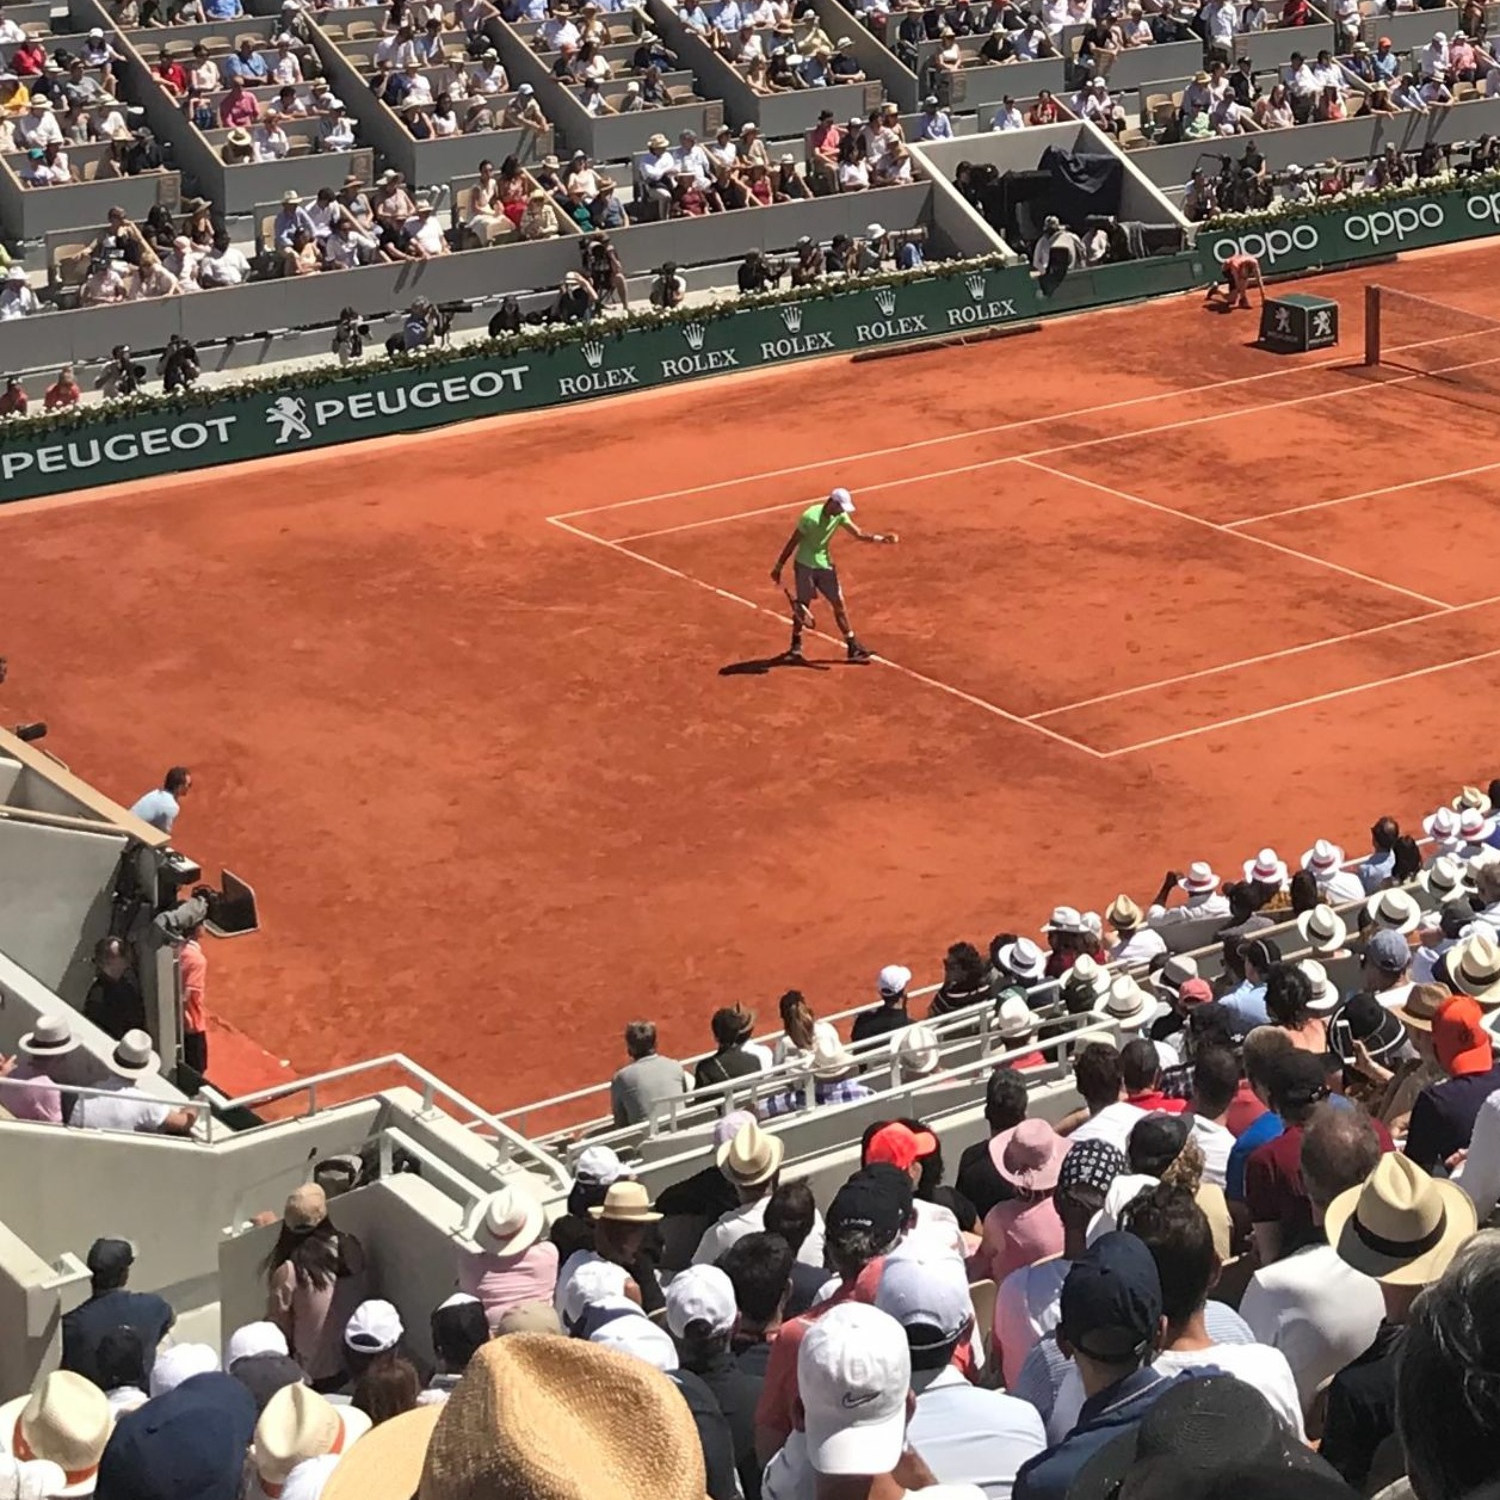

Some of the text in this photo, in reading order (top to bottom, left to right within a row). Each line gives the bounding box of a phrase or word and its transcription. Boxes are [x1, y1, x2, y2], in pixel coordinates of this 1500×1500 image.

[1344, 203, 1444, 245] oppo
[947, 298, 1018, 326] ROLEX
[856, 314, 928, 342] ROLEX
[760, 331, 836, 360] ROLEX
[661, 348, 739, 378] ROLEX
[316, 365, 531, 426] PEUGEOT
[558, 365, 640, 397] ROLEX
[2, 415, 237, 480] PEUGEOT
